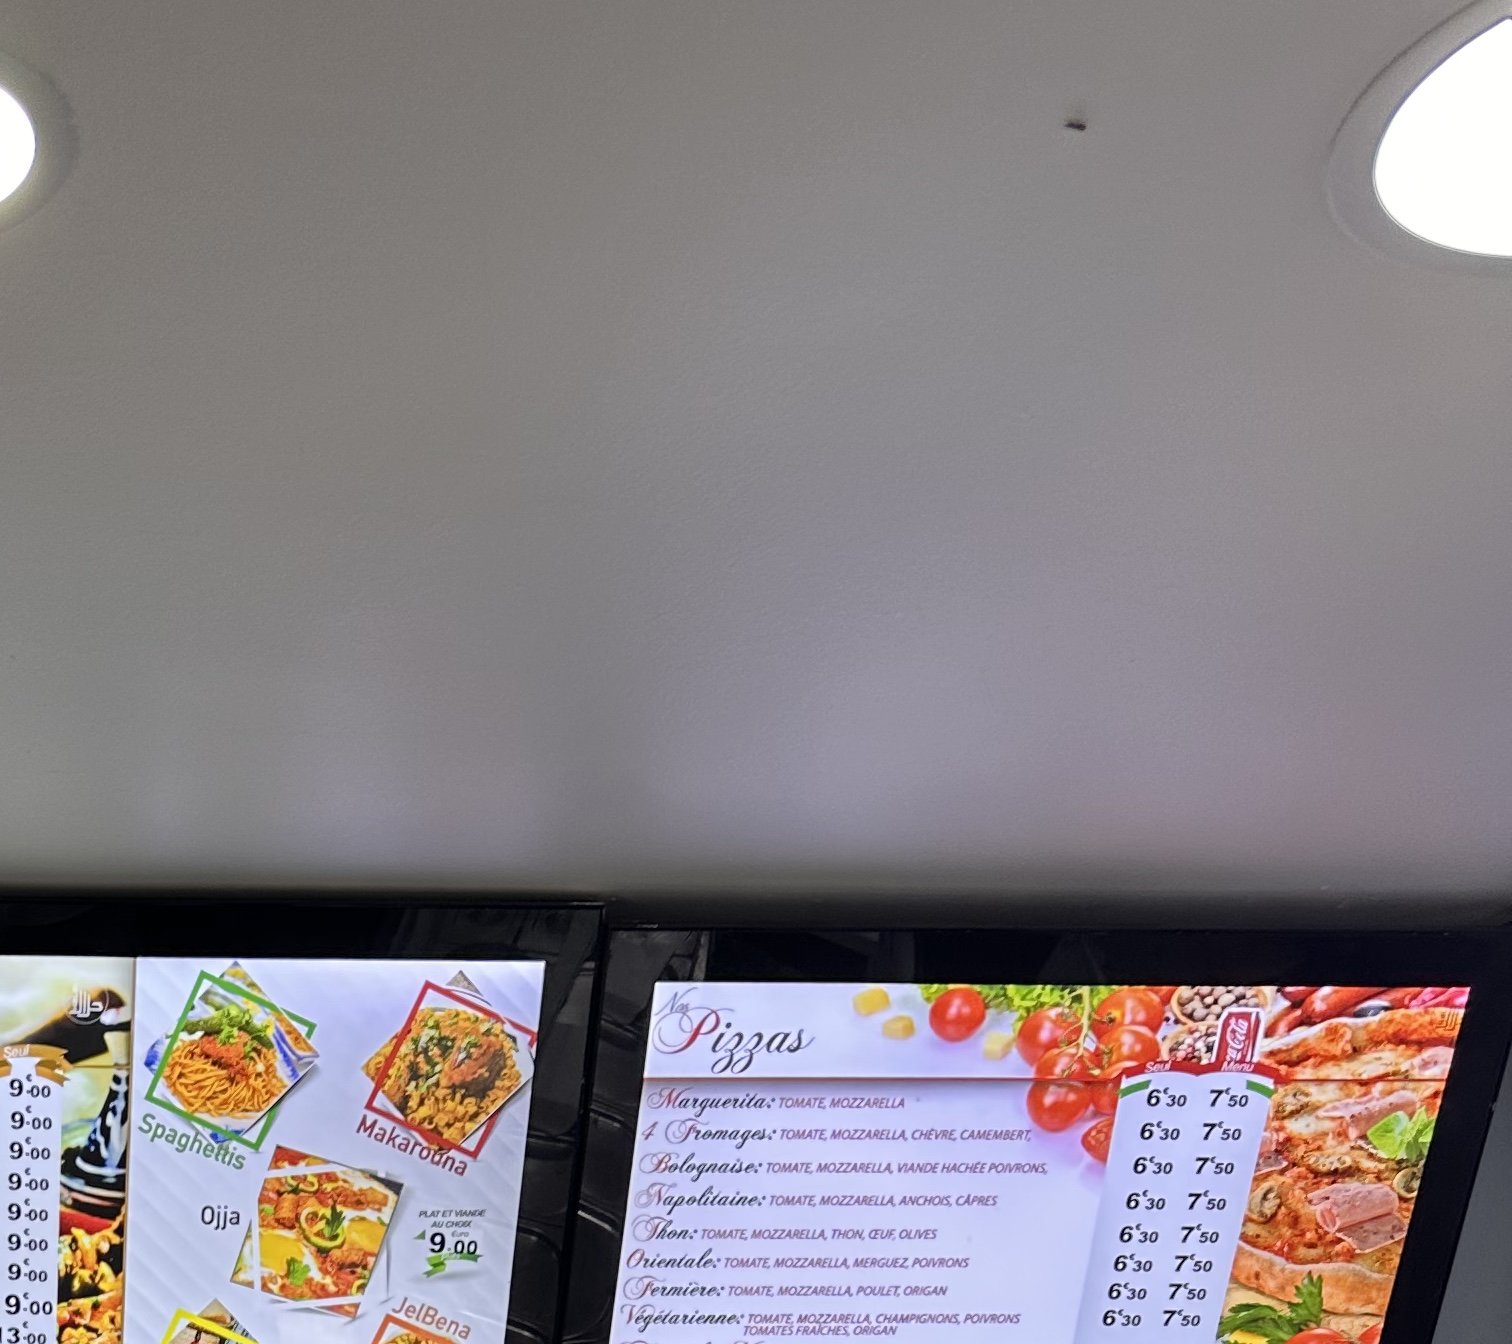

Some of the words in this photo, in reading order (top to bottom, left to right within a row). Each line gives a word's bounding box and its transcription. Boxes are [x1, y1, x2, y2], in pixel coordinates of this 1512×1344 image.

[652, 1007, 817, 1074] Pizzas
[1221, 1060, 1255, 1073] Menu
[646, 1085, 776, 1117] Marguerita:
[778, 1097, 826, 1109] TOMATE,
[829, 1097, 905, 1109] MOZZARELLA
[138, 1112, 247, 1171] Spaghettis
[665, 1117, 777, 1149] Fromages:
[780, 1128, 829, 1142] TOMATE,
[830, 1128, 908, 1141] MOZZARELLA,
[960, 1128, 1031, 1141] CAMEMBERT,
[639, 1150, 762, 1181] Bolognaise:
[766, 1161, 814, 1175] TOMATE,
[817, 1161, 894, 1174] MOZZARELLA,
[897, 1162, 940, 1174] VIANDE
[942, 1160, 986, 1174] HACHÉE
[988, 1162, 1048, 1175] POIVRONS,
[636, 1182, 766, 1214] Napolitaine:
[770, 1194, 817, 1207] TOMATE,
[819, 1194, 896, 1207] MOZZARELLA,
[899, 1194, 953, 1207] ANCHOIS,
[200, 1205, 241, 1229] Ojja
[419, 1210, 440, 1218] PLAT
[631, 1214, 697, 1242] Thon:
[701, 1228, 749, 1241] TOMATE,
[751, 1228, 828, 1241] MOZZARELLA,
[831, 1228, 865, 1241] THON,
[899, 1228, 938, 1240] OLIVES
[429, 1232, 478, 1254] 9.00
[626, 1248, 721, 1271] Orientale:
[622, 1275, 726, 1304] Fermière:
[391, 1296, 472, 1340] JelBena
[620, 1304, 745, 1333] Végétarienne:
